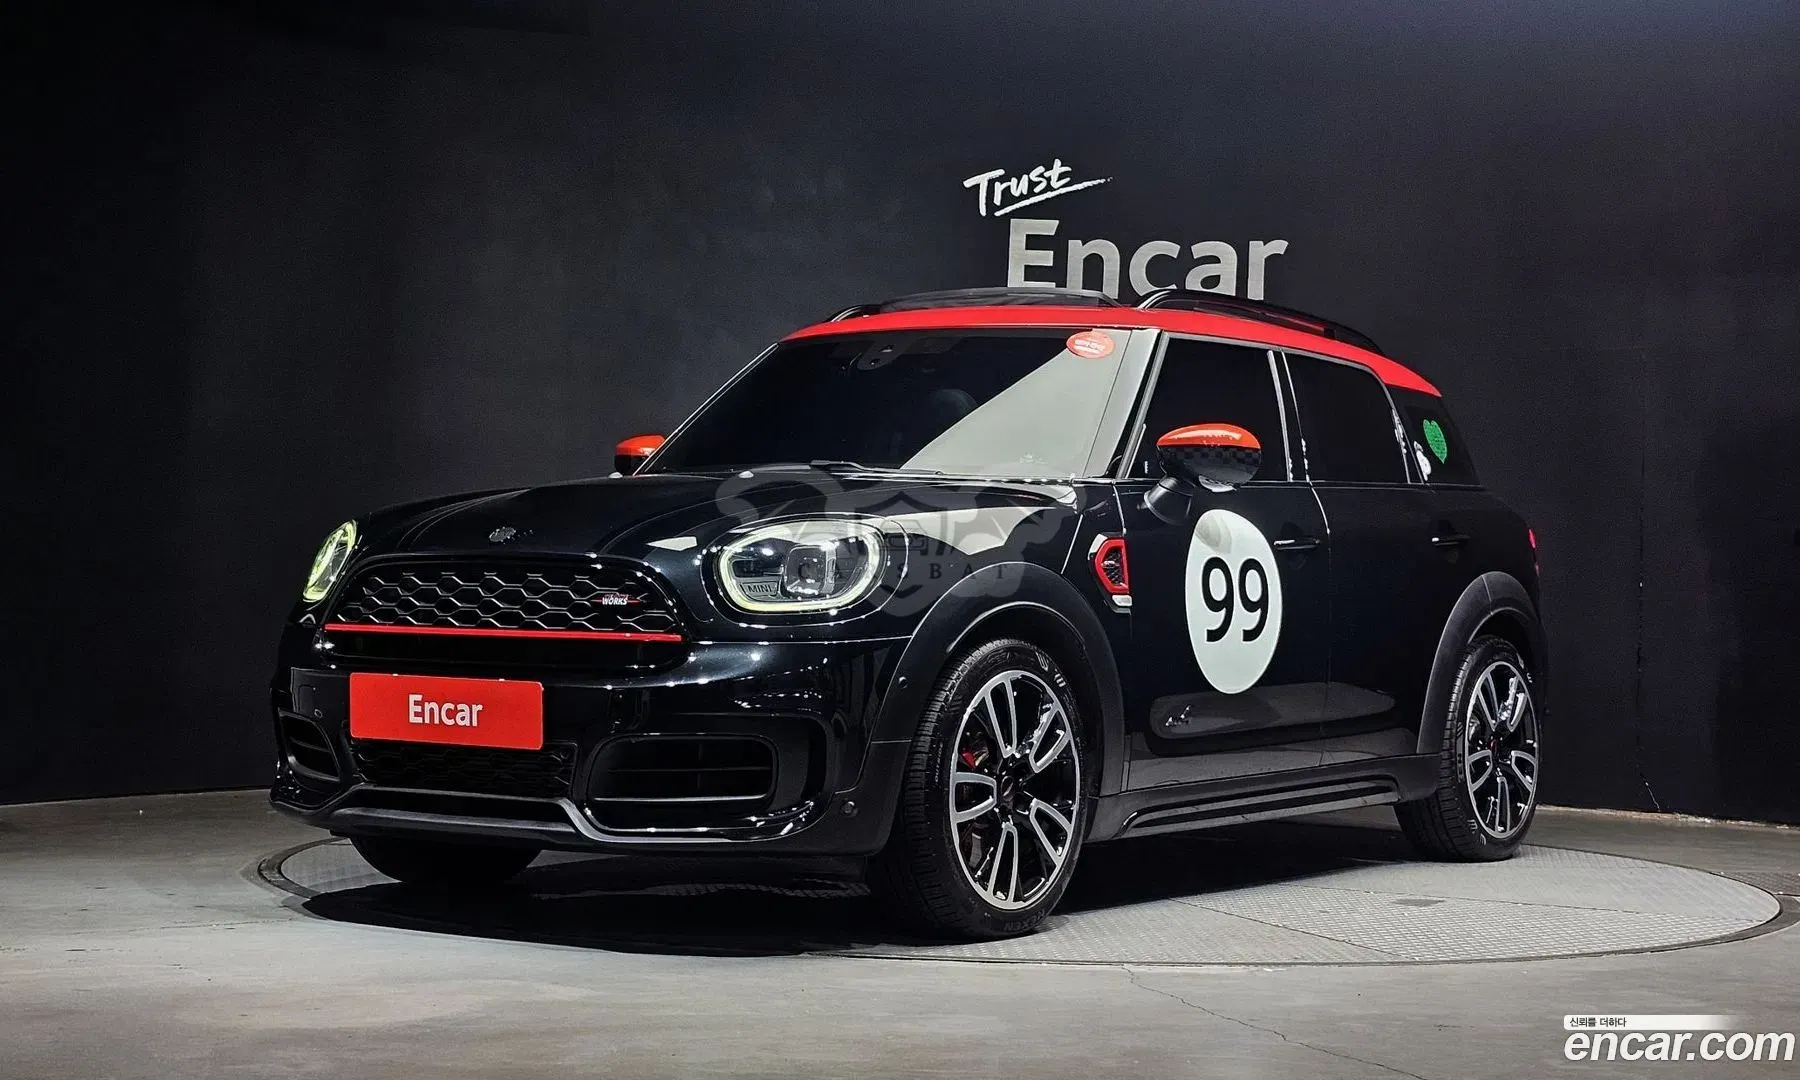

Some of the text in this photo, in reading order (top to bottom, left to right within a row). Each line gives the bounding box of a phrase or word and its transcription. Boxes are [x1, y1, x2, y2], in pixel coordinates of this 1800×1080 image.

[963, 158, 1072, 217] Trust
[1007, 218, 1289, 301] Encar
[602, 596, 628, 606] WORKS
[747, 584, 773, 593] MINI
[1201, 556, 1270, 643] 99
[408, 693, 484, 728] Encar
